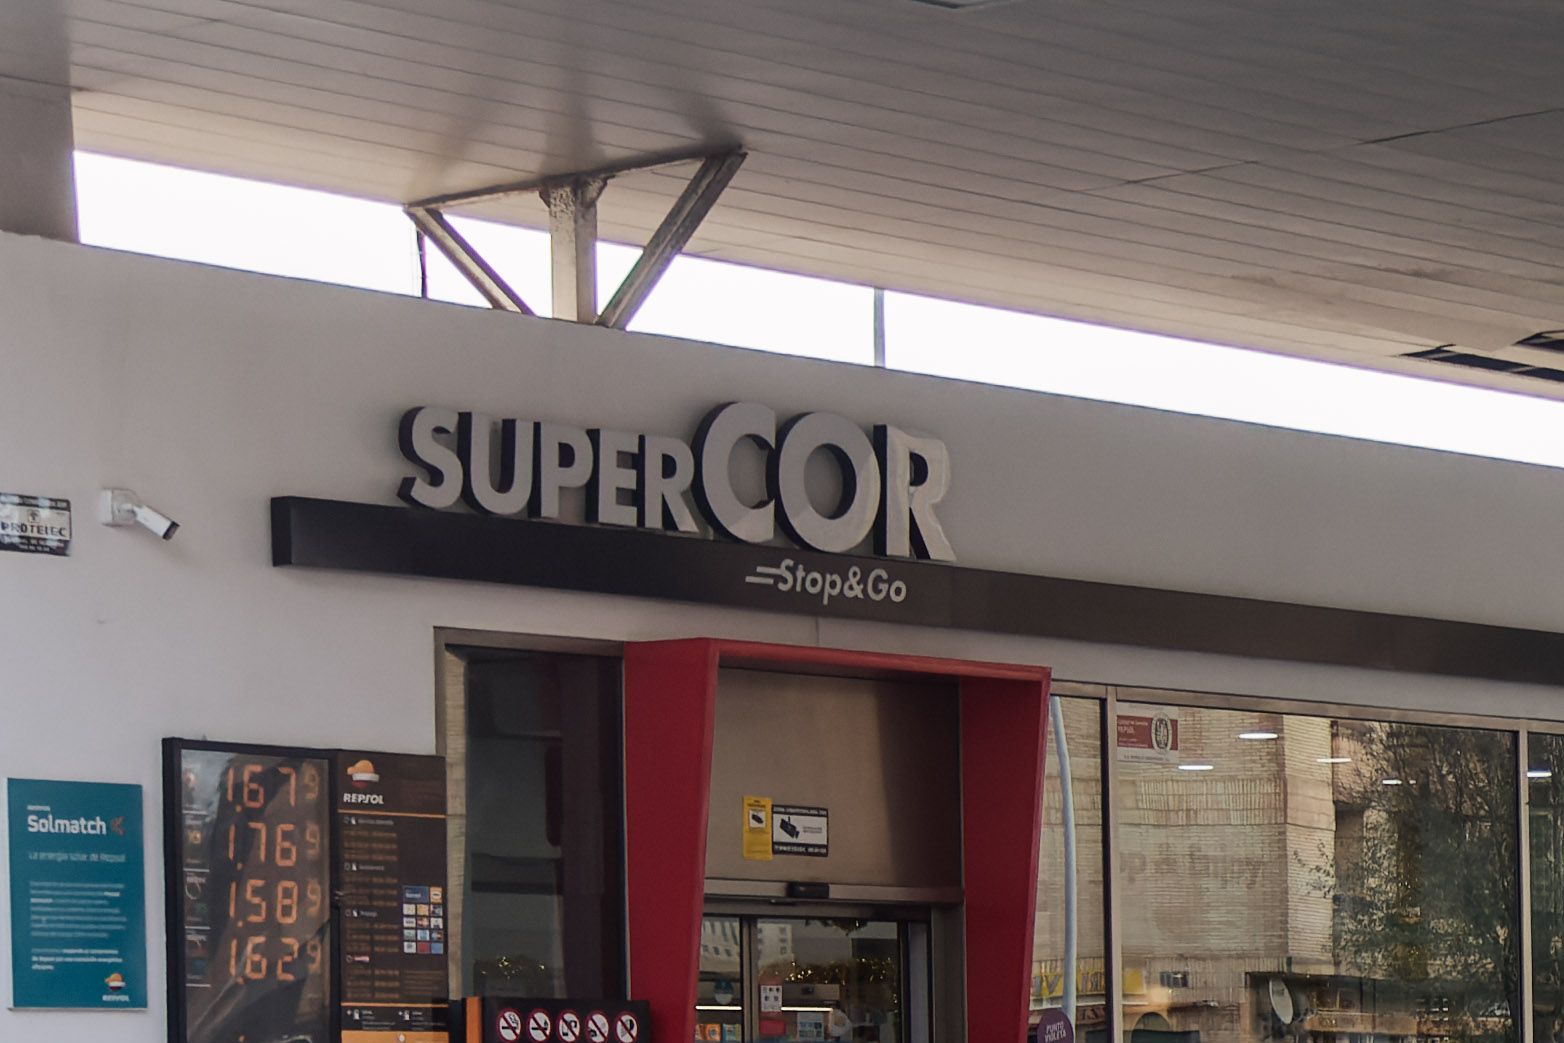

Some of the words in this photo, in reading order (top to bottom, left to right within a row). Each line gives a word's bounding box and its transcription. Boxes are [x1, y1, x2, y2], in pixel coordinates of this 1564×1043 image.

[398, 401, 957, 561] SUPERCOR
[776, 559, 908, 605] Stop&Go
[343, 793, 385, 804] REPSOL
[27, 814, 107, 835] Solmatch
[1046, 1021, 1065, 1034] PUNTO
